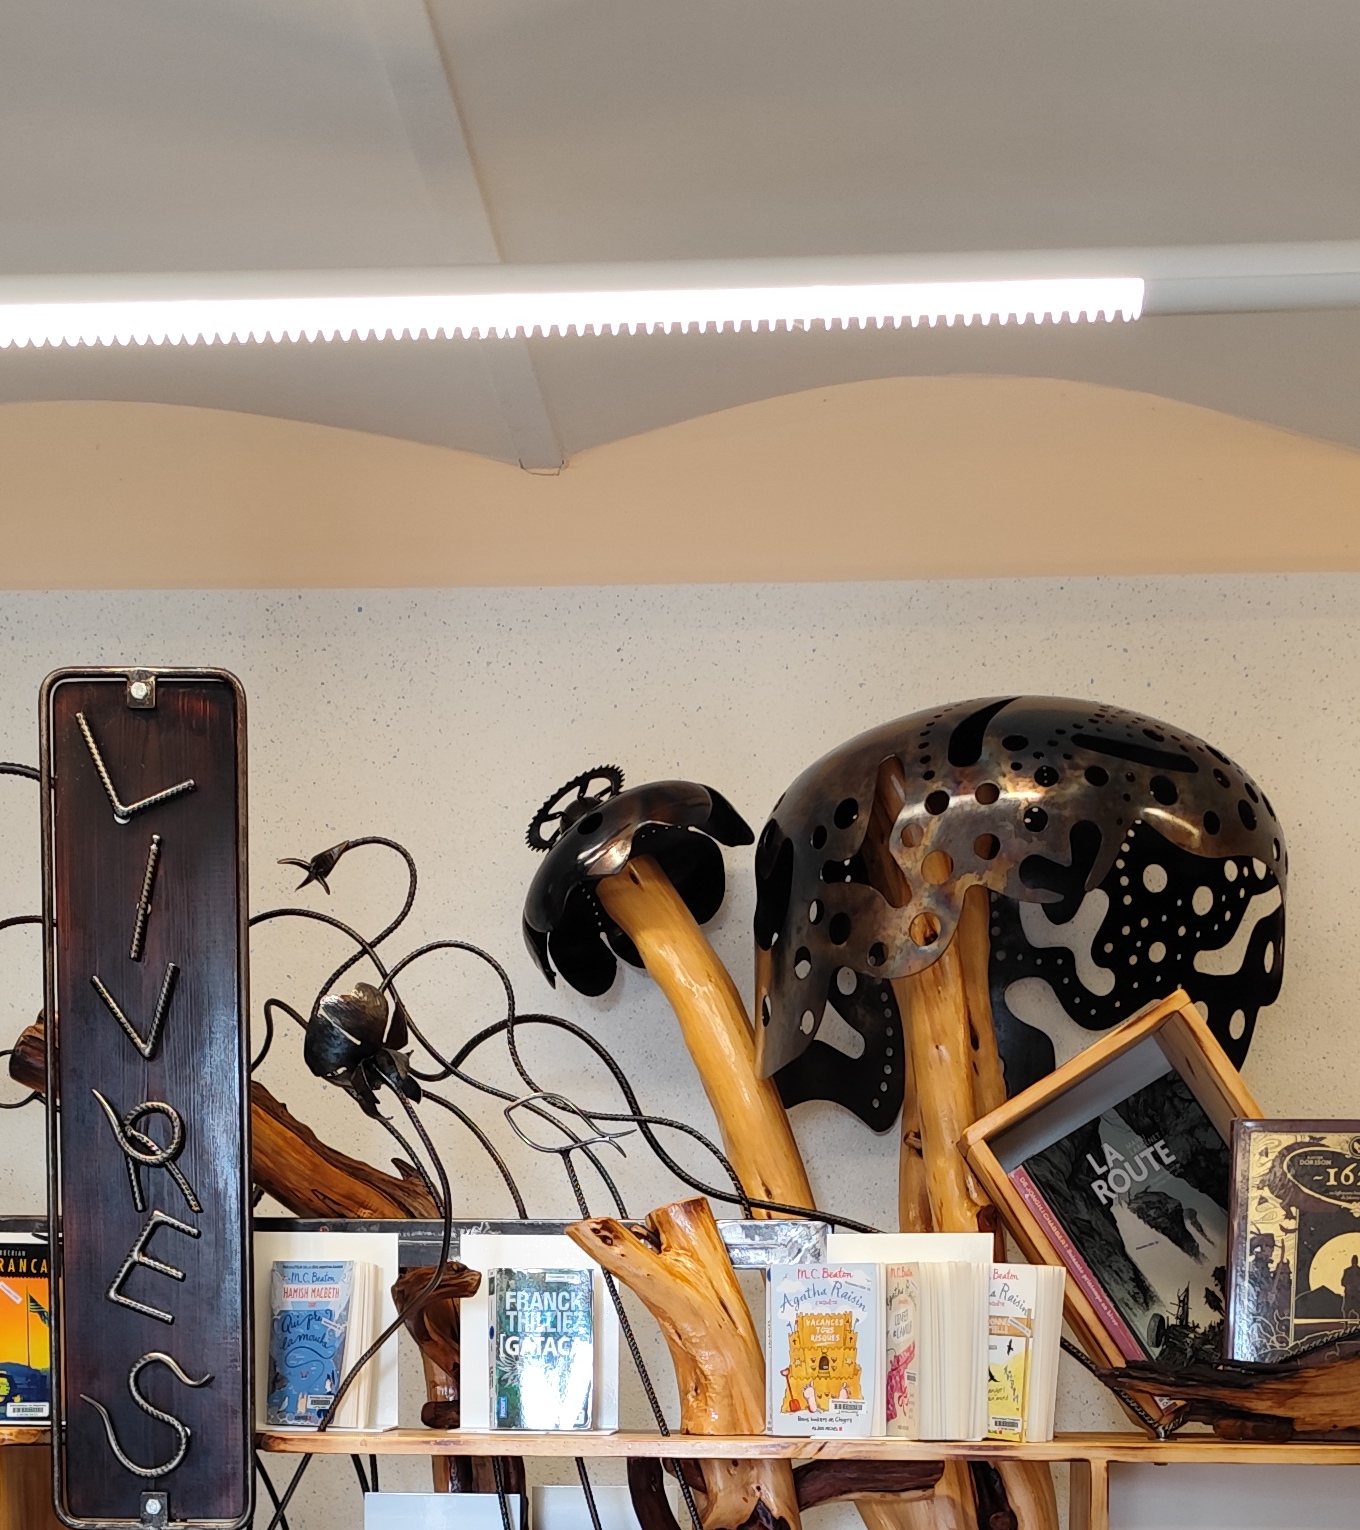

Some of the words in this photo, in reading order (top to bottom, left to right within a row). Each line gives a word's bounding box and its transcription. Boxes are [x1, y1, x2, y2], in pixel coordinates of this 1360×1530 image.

[76, 711, 215, 1478] LIVRES
[1086, 1142, 1125, 1175] LA
[1090, 1139, 1176, 1205] ROUTE
[312, 1272, 336, 1283] Beaton
[822, 1267, 854, 1279] Beaton
[993, 1268, 1019, 1280] Beaton
[283, 1287, 309, 1299] HAMISH
[780, 1283, 828, 1313] Agatha
[830, 1280, 867, 1312] Raisin
[999, 1282, 1028, 1316] Raisin
[505, 1291, 584, 1311] FRANCK
[805, 1318, 845, 1326] VACANCES
[815, 1326, 835, 1334] TOUS
[810, 1334, 840, 1342] RISQUES
